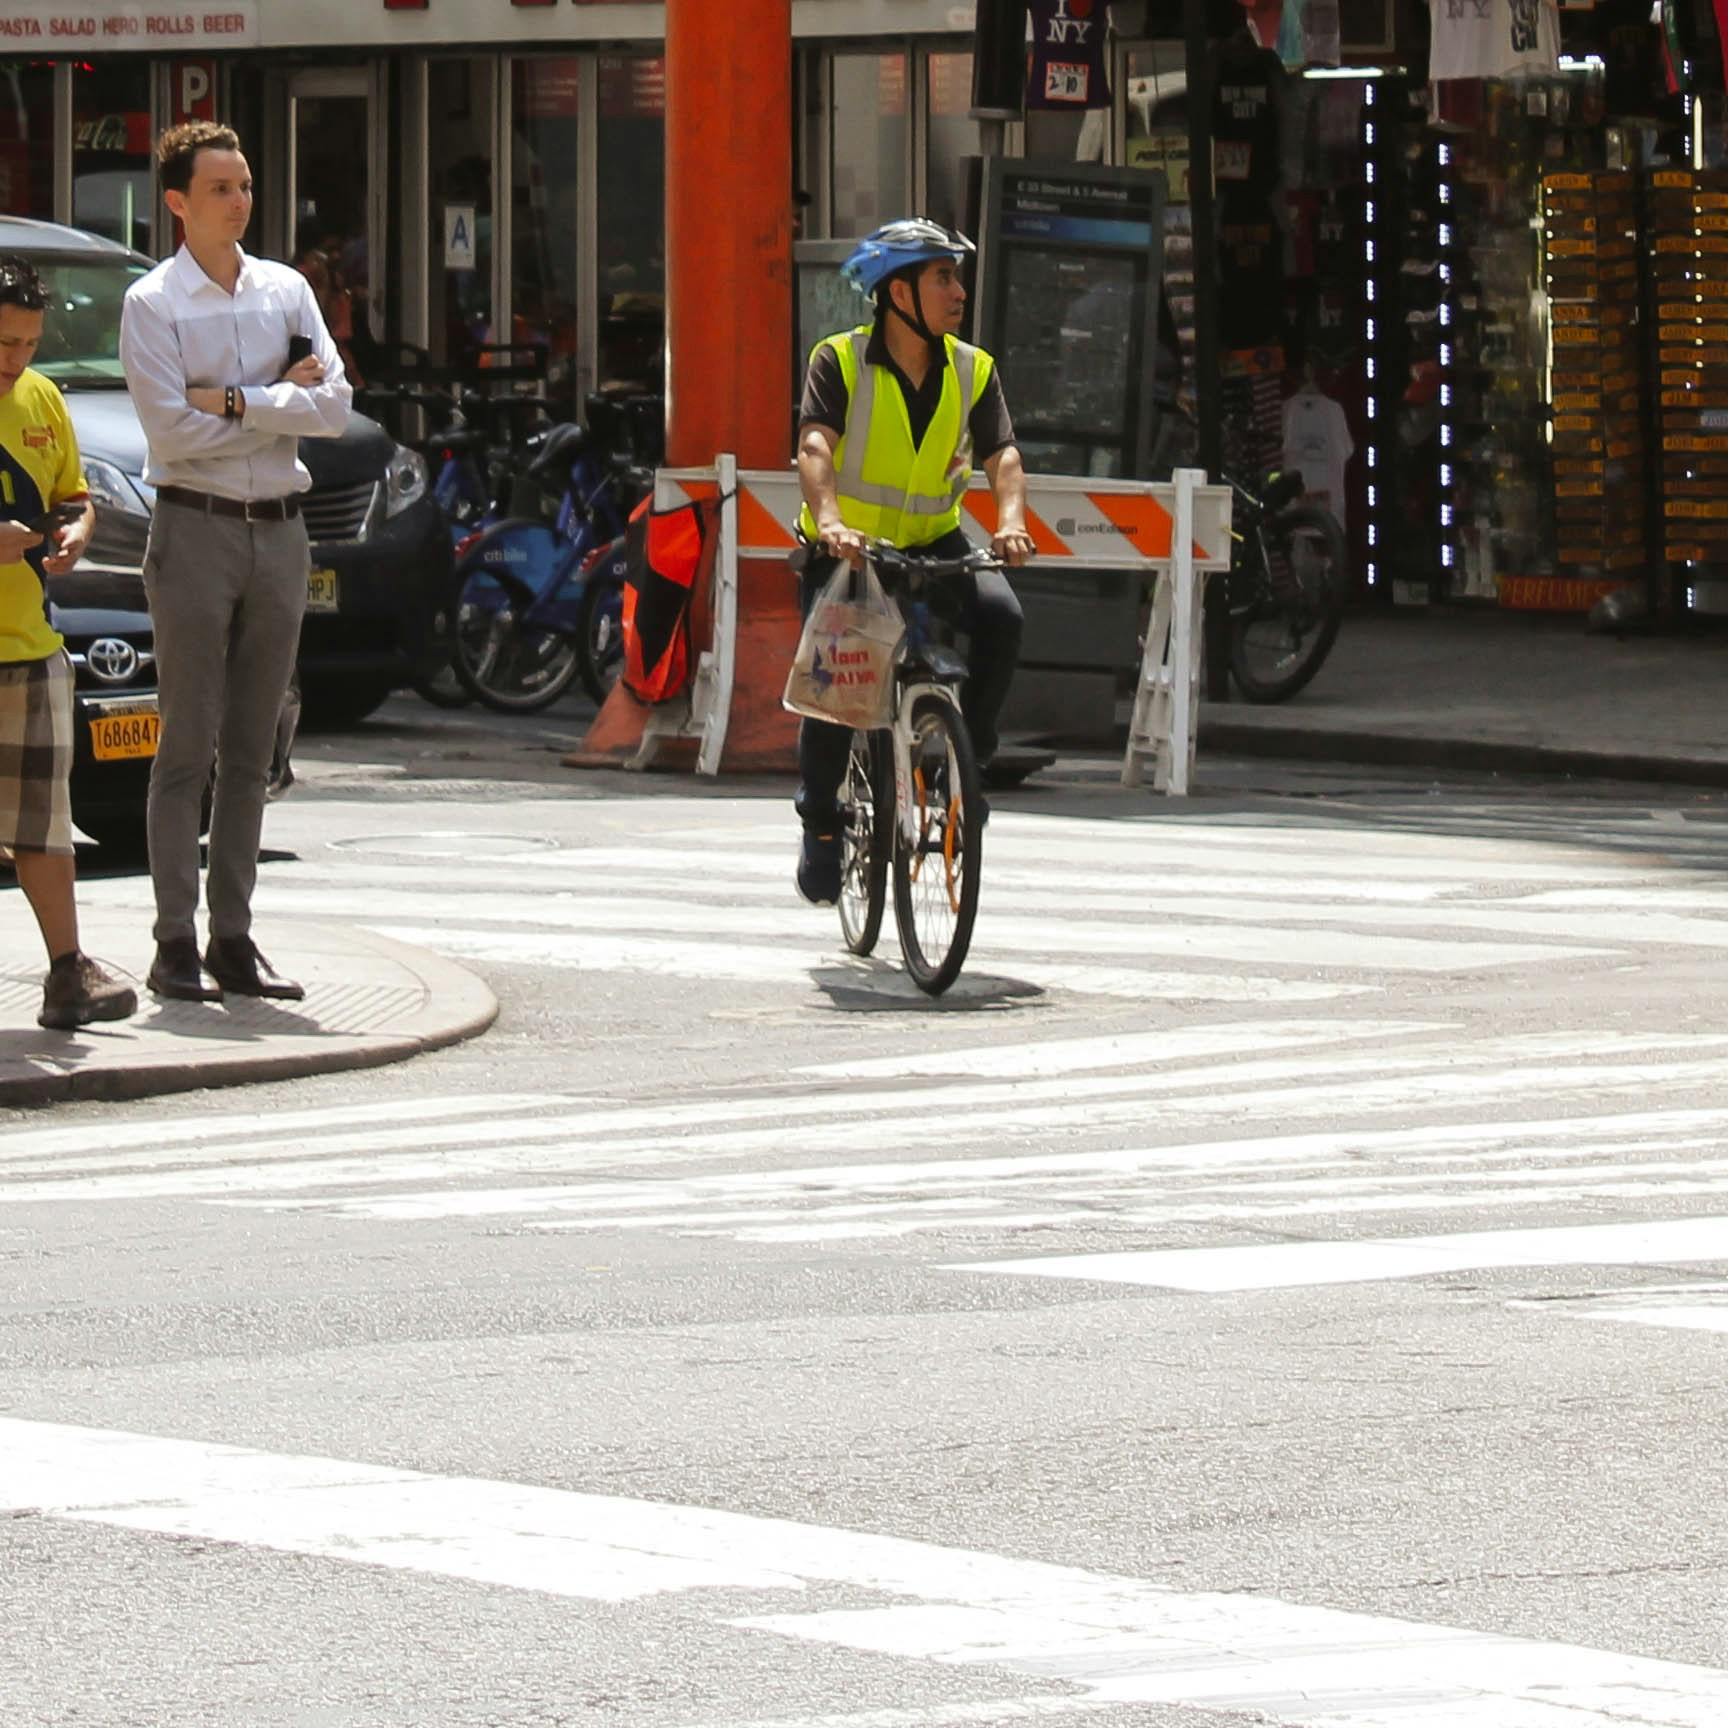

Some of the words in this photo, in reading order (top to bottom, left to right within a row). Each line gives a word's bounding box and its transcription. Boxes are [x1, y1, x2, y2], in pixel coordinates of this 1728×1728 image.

[49, 15, 96, 37] SALAD
[102, 16, 139, 37] HERO
[146, 14, 195, 36] ROLLS
[203, 13, 246, 35] BEER
[1046, 18, 1093, 44] NY
